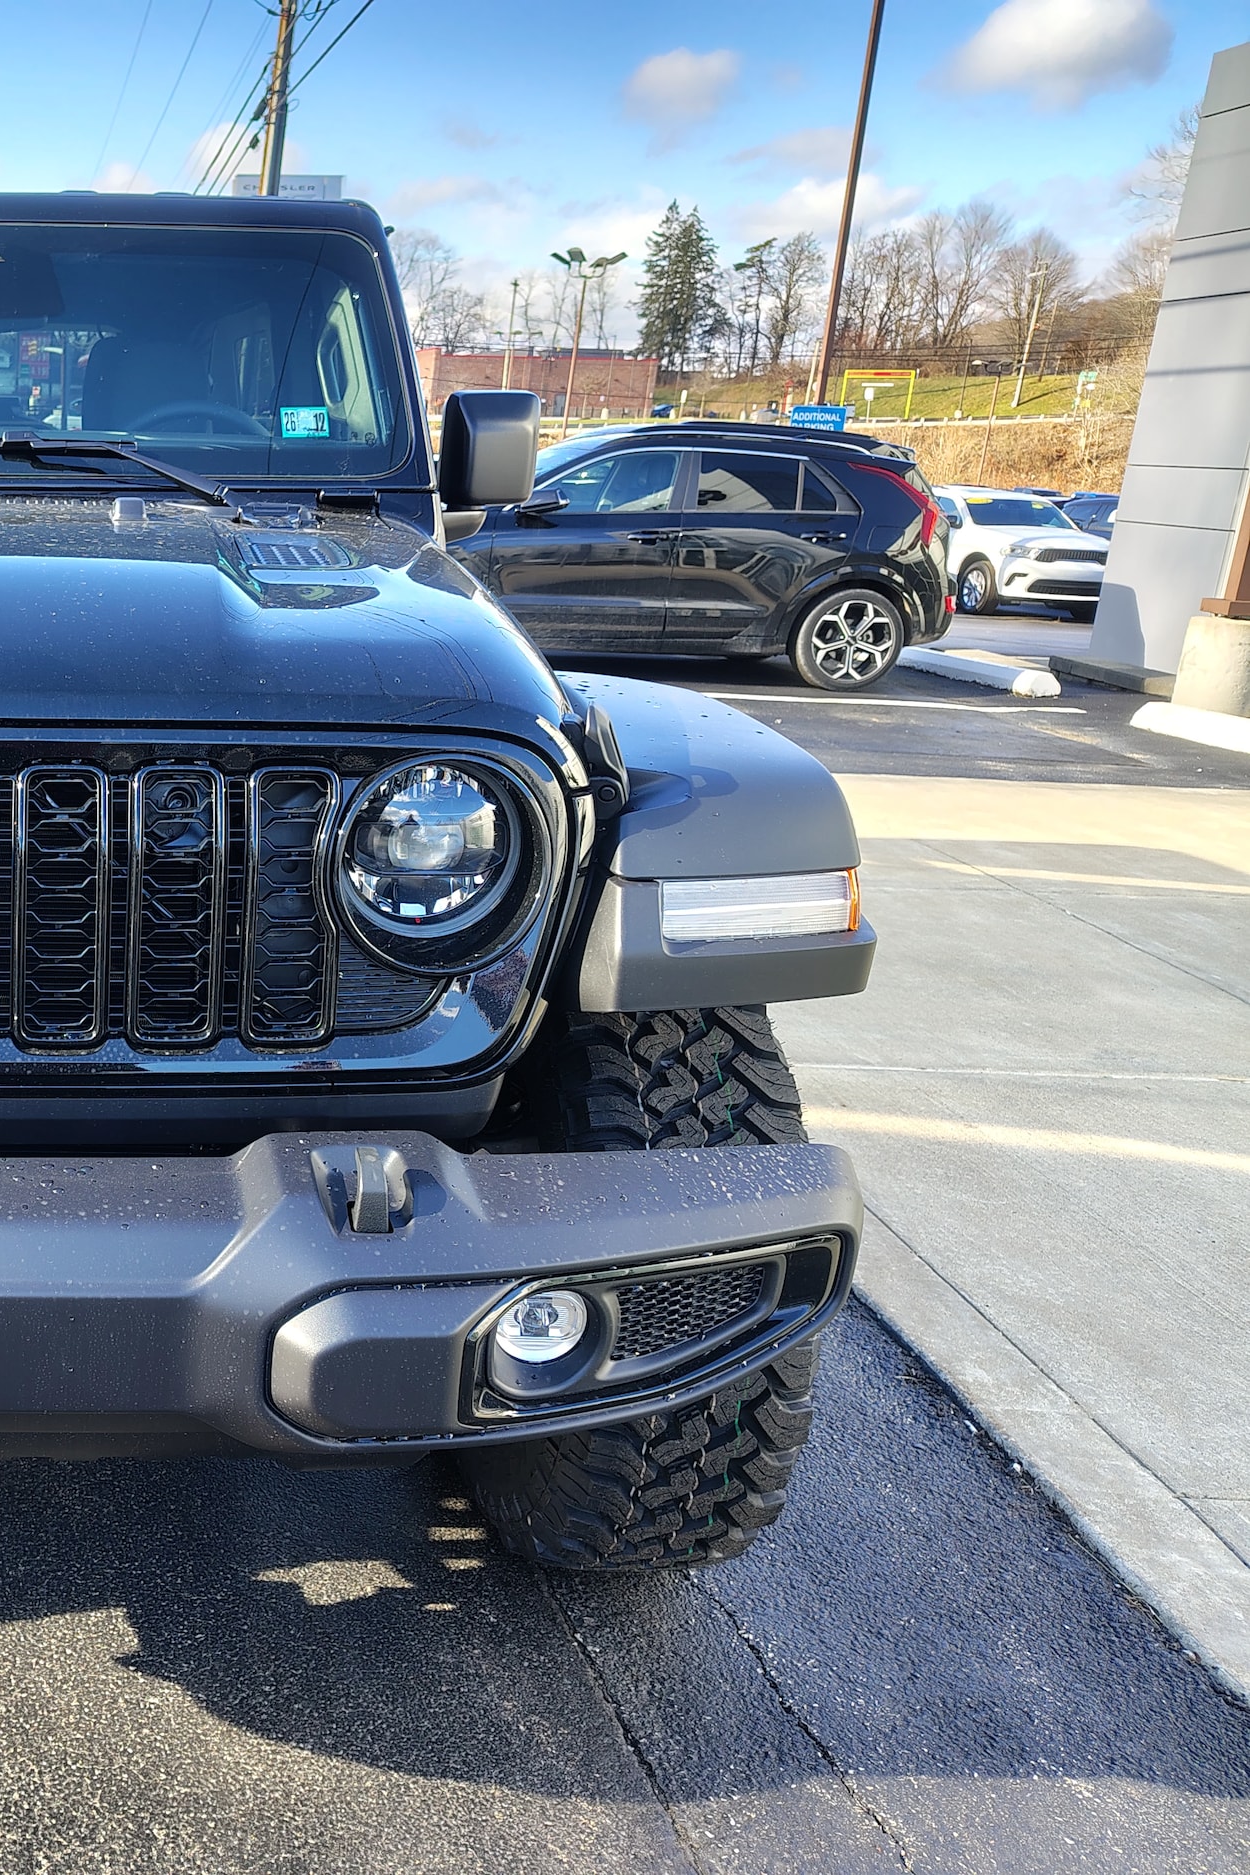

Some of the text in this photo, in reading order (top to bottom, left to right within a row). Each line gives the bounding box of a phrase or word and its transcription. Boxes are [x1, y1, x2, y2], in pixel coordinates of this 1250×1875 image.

[284, 412, 296, 431] 26
[313, 412, 326, 431] 12
[792, 412, 842, 421] ADDITIONAL
